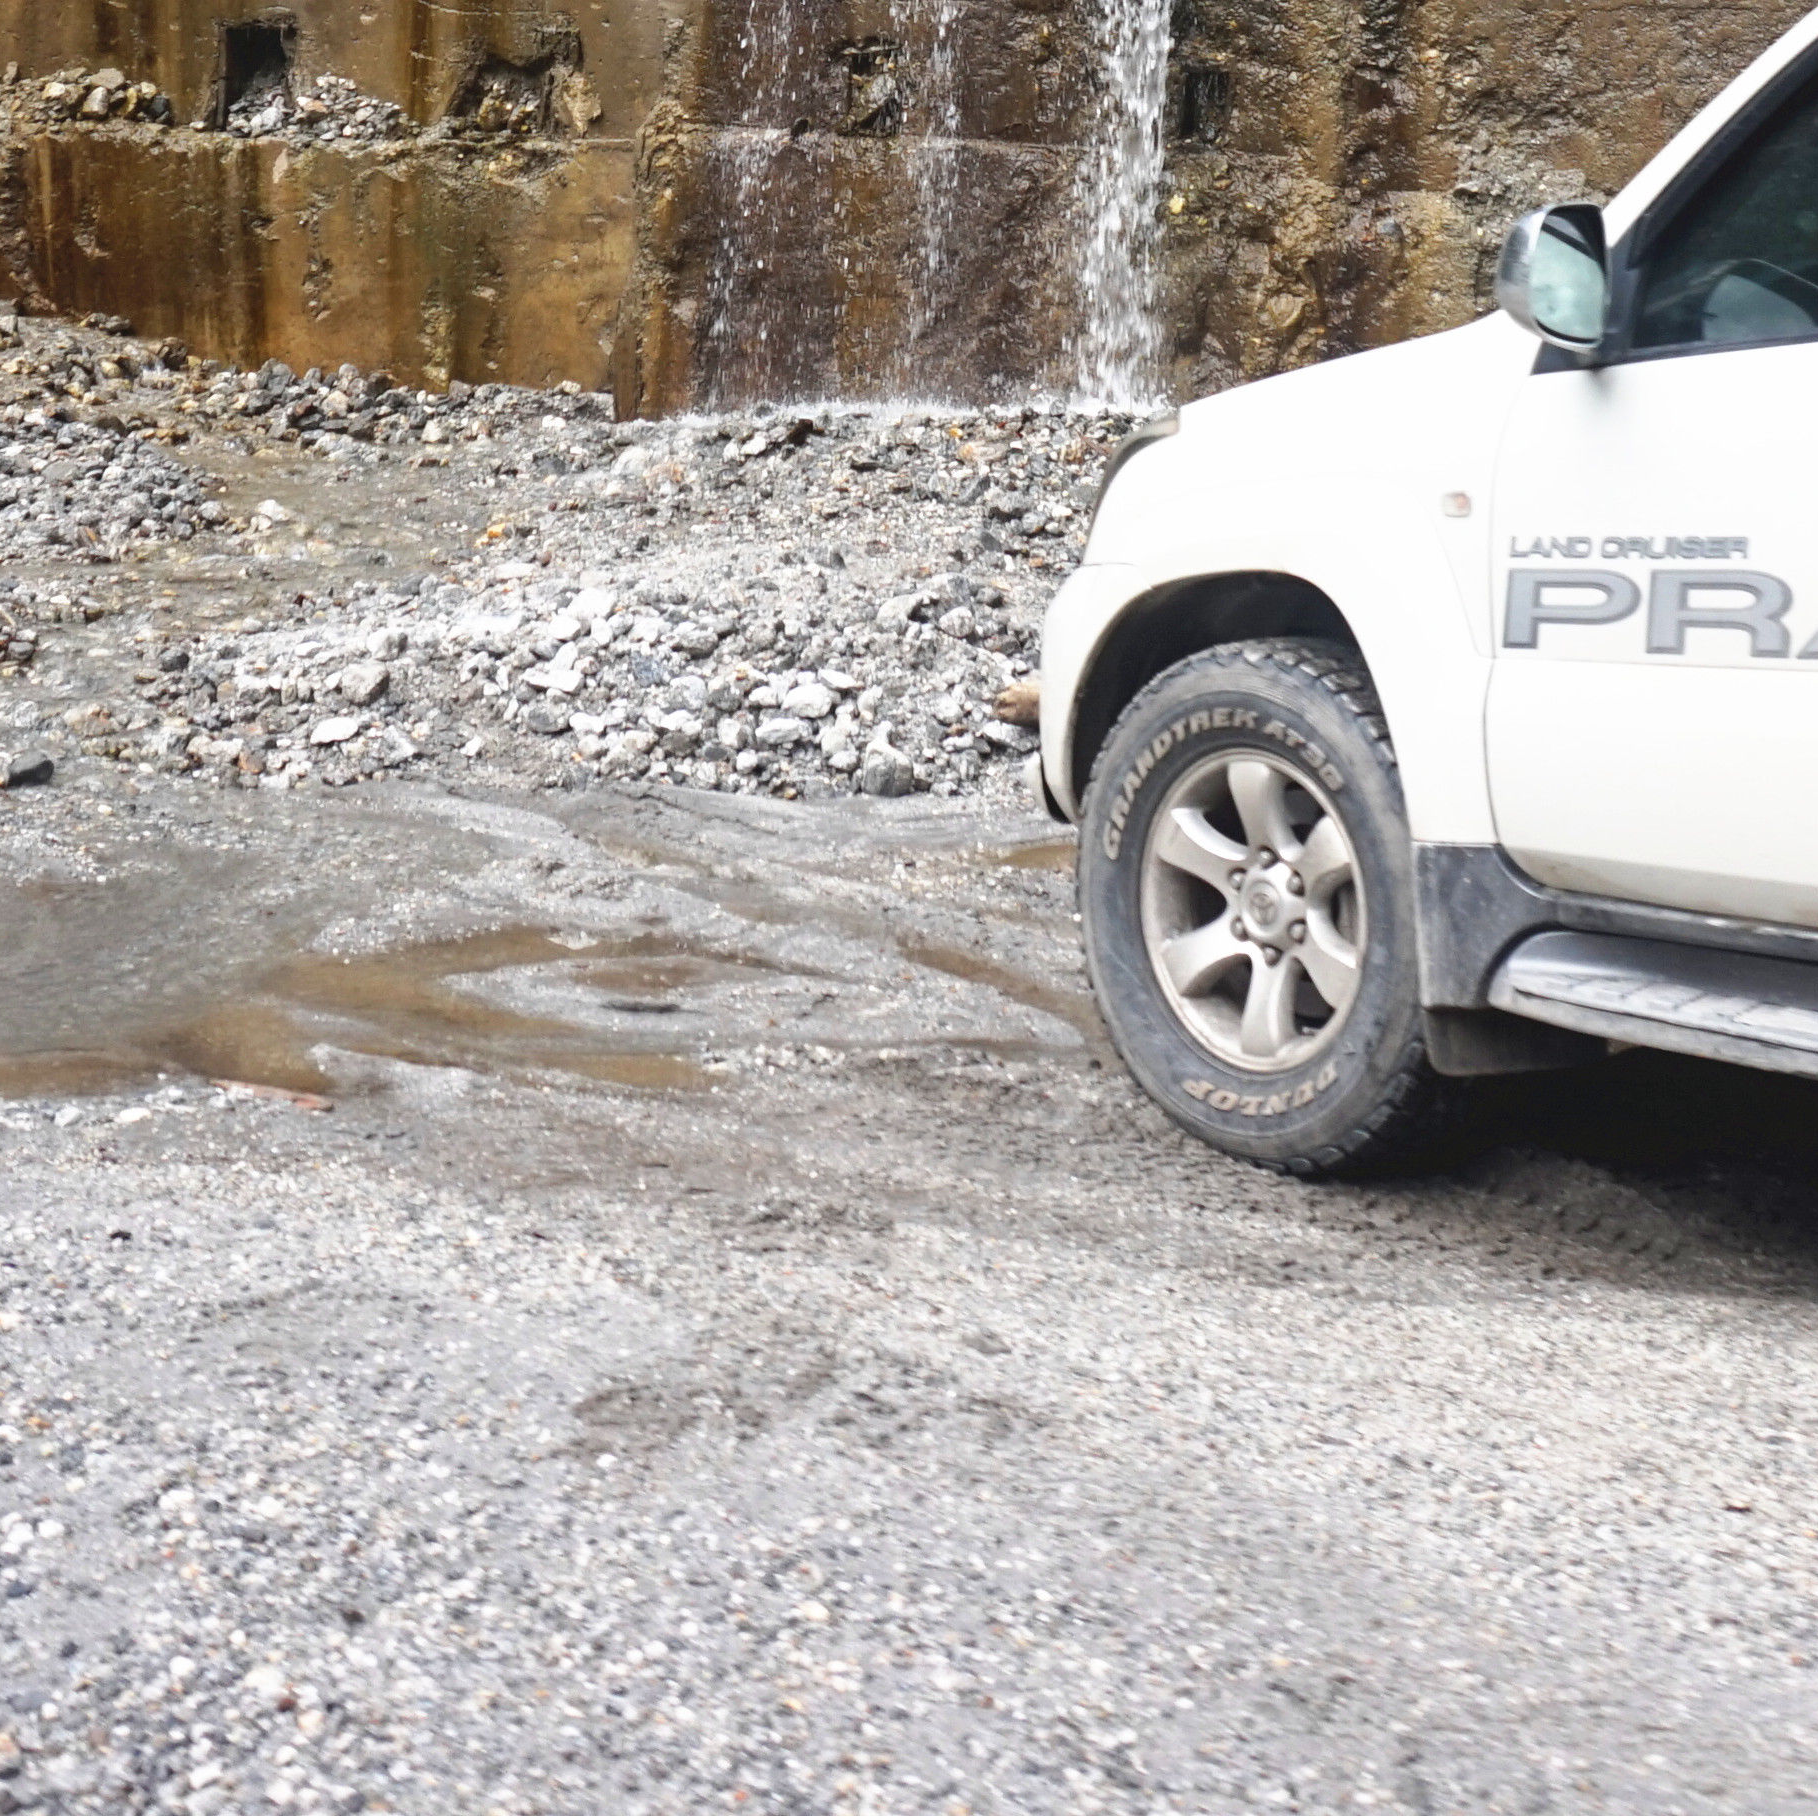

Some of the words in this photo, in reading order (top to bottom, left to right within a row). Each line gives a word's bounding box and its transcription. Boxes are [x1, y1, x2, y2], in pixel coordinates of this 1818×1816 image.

[1510, 536, 1591, 559] LAND
[1601, 536, 1749, 560] CRUISER
[1103, 707, 1259, 861] GRANDTREK
[1182, 1061, 1338, 1117] DUNLOP
